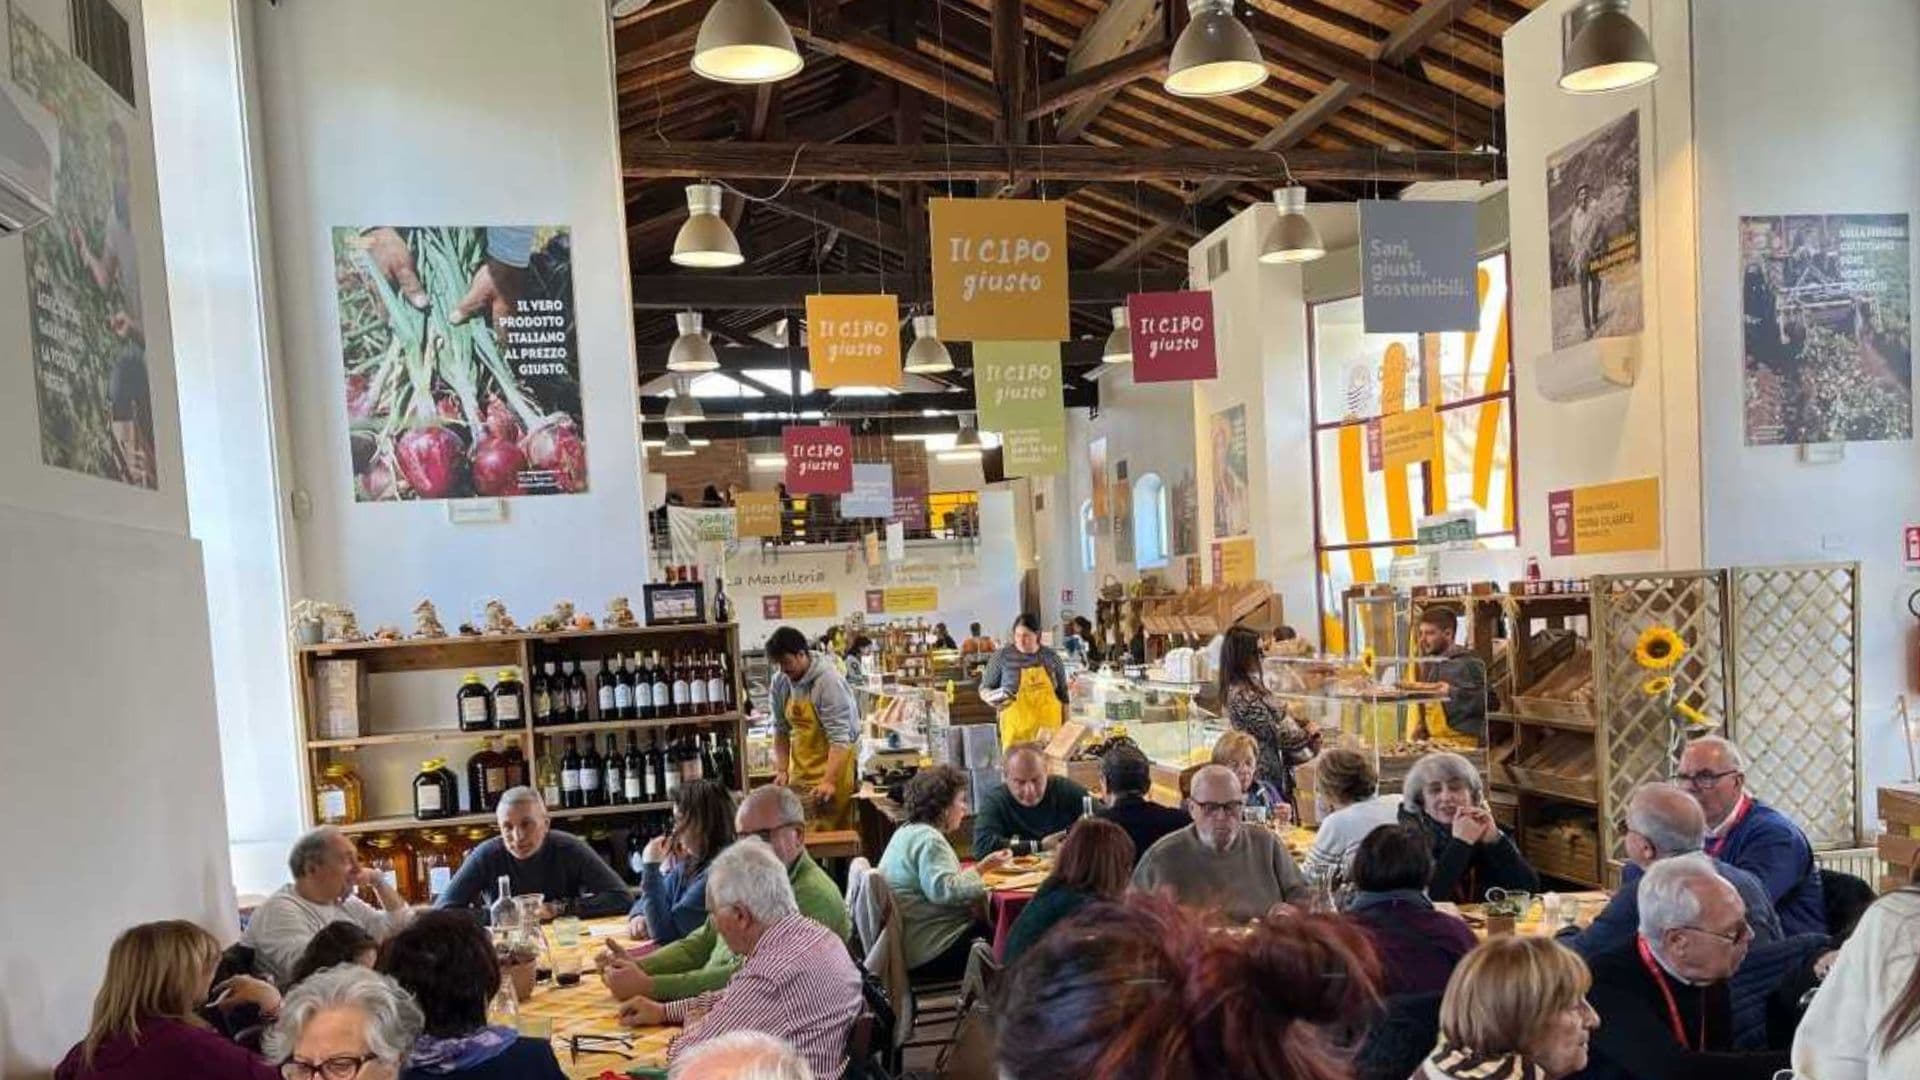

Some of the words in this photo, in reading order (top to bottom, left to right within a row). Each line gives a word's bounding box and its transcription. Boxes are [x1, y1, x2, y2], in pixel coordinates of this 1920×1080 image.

[949, 237, 971, 262] Il
[978, 237, 1051, 264] CIBO
[1369, 238, 1414, 260] Sani,
[1370, 259, 1428, 282] giusti,
[962, 271, 1042, 302] giusto
[1371, 276, 1470, 298] sostenibili.
[517, 300, 530, 312] IL
[530, 300, 563, 312] VERO
[499, 315, 564, 328] PRODOTTO
[820, 320, 834, 337] Il
[839, 320, 889, 338] CIBO
[1140, 317, 1155, 335] Il
[1159, 315, 1204, 334] CIBO
[508, 331, 566, 344] ITALIANO
[504, 347, 520, 360] AL
[520, 346, 568, 360] PREZZO
[829, 341, 883, 363] giusto
[1149, 337, 1199, 359] giusto
[518, 362, 568, 375] GIUSTO.
[995, 384, 1047, 407] giusto
[807, 443, 844, 458] CIBO
[799, 460, 840, 476] giusto
